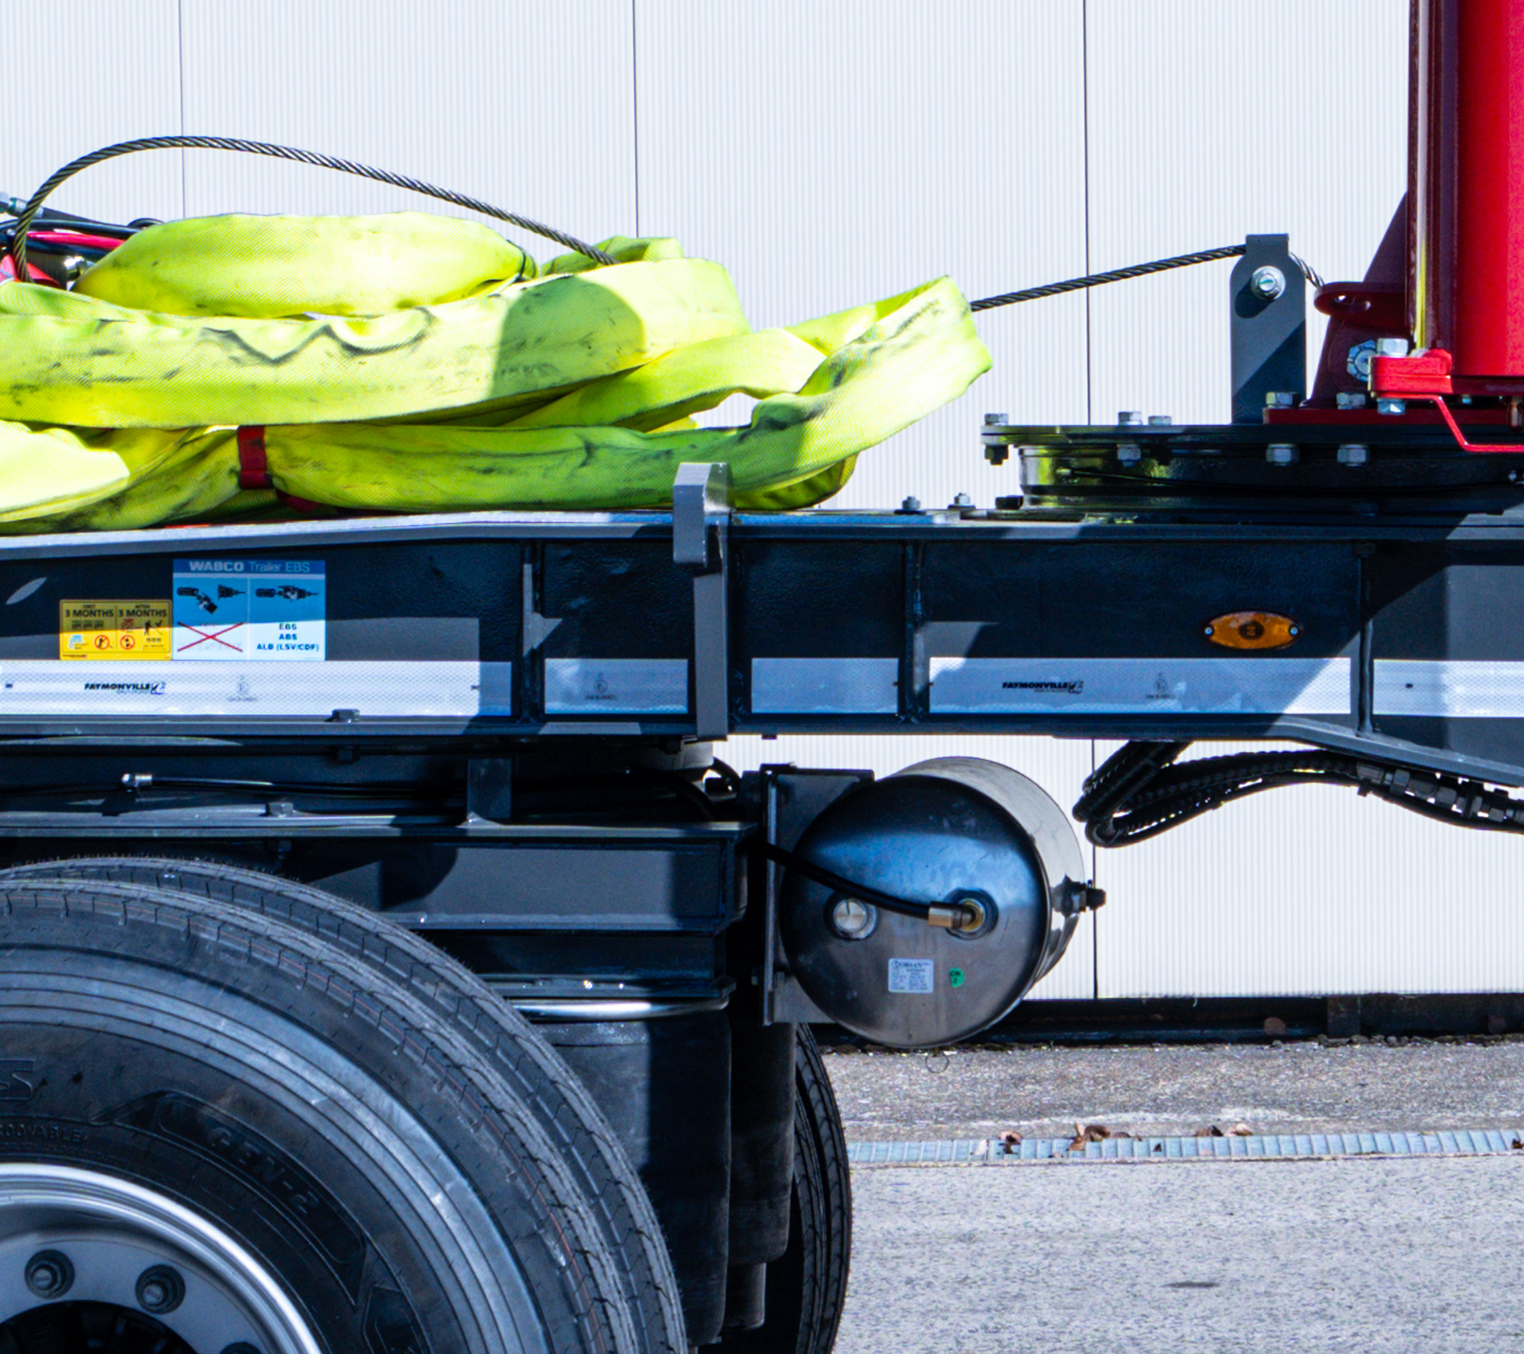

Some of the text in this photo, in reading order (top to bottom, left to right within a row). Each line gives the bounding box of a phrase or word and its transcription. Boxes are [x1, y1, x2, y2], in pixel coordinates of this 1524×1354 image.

[188, 561, 310, 573] WABCO Trailer EBS
[65, 609, 114, 618] 3 MONTHS
[118, 609, 168, 618] 3 MONTHS
[84, 683, 150, 691] FAYMONVILLE
[1002, 681, 1068, 690] FAYMONVILLE
